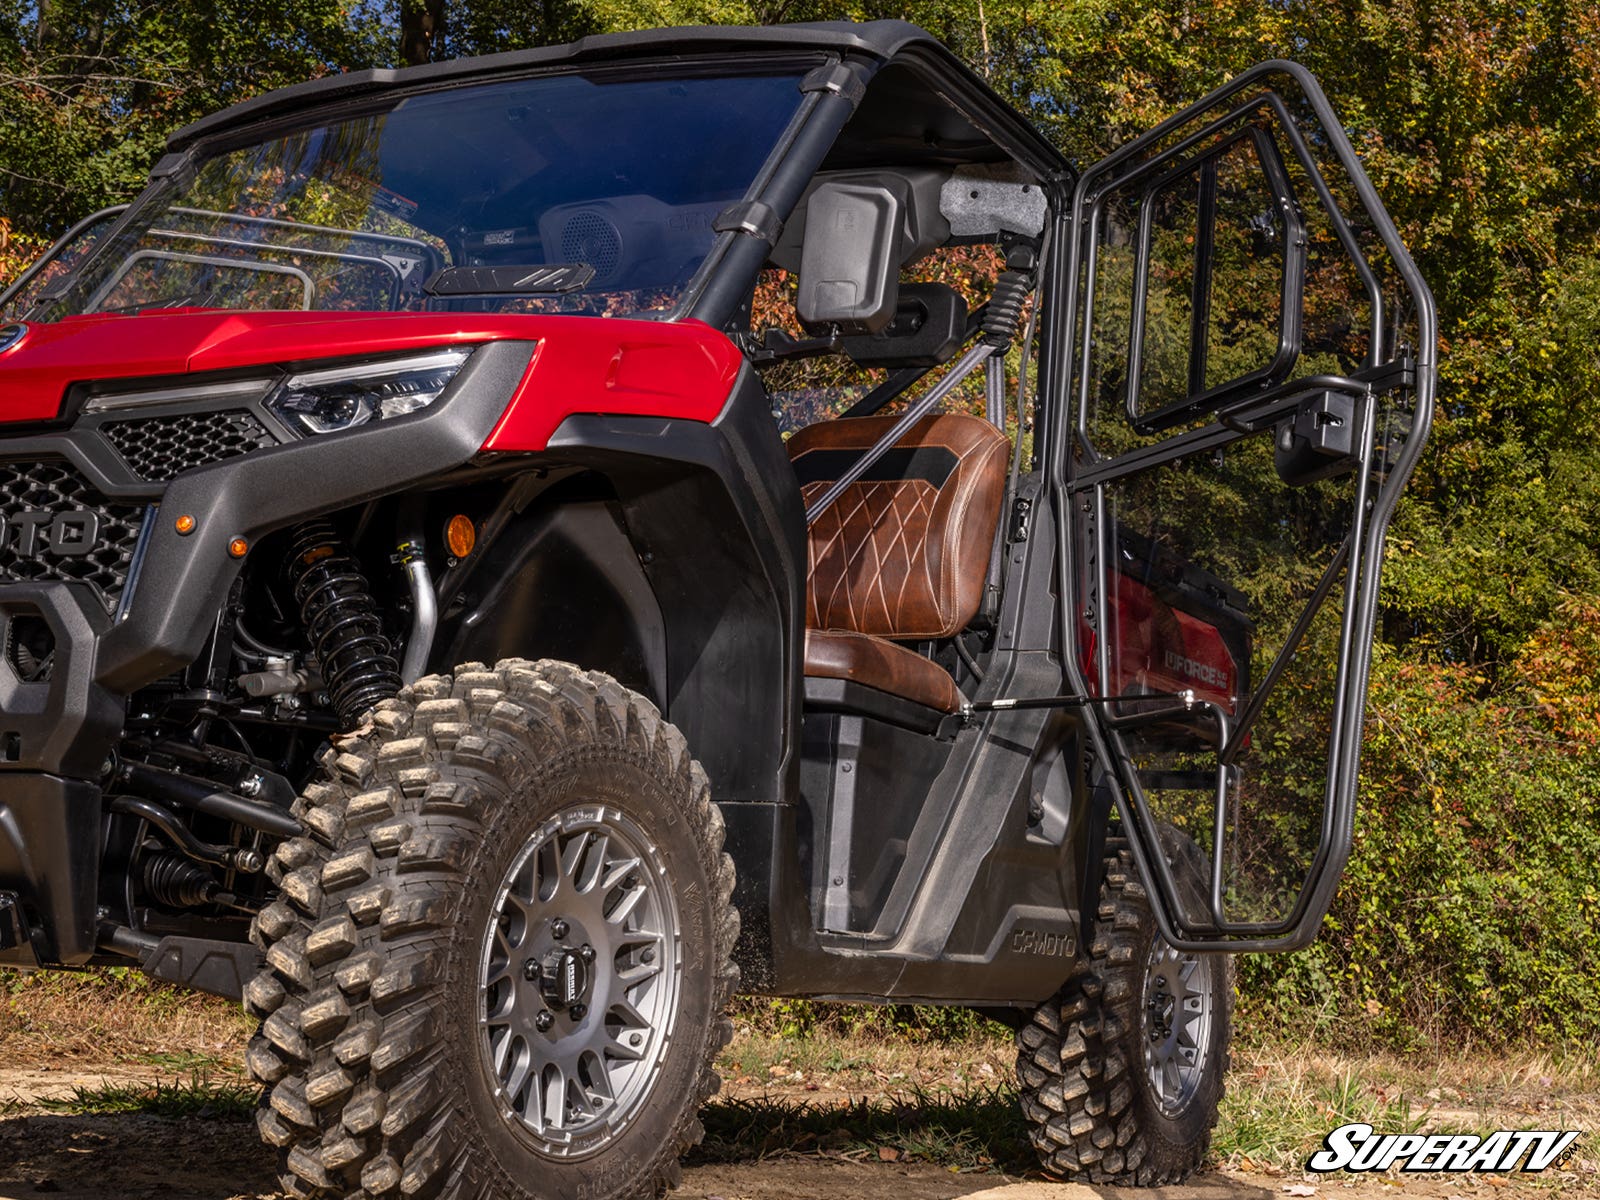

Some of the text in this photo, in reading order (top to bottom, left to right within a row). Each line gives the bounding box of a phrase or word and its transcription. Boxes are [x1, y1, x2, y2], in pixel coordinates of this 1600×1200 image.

[0, 511, 99, 556] TO
[1164, 650, 1216, 684] UFORCE
[1012, 929, 1077, 957] CFMOTO
